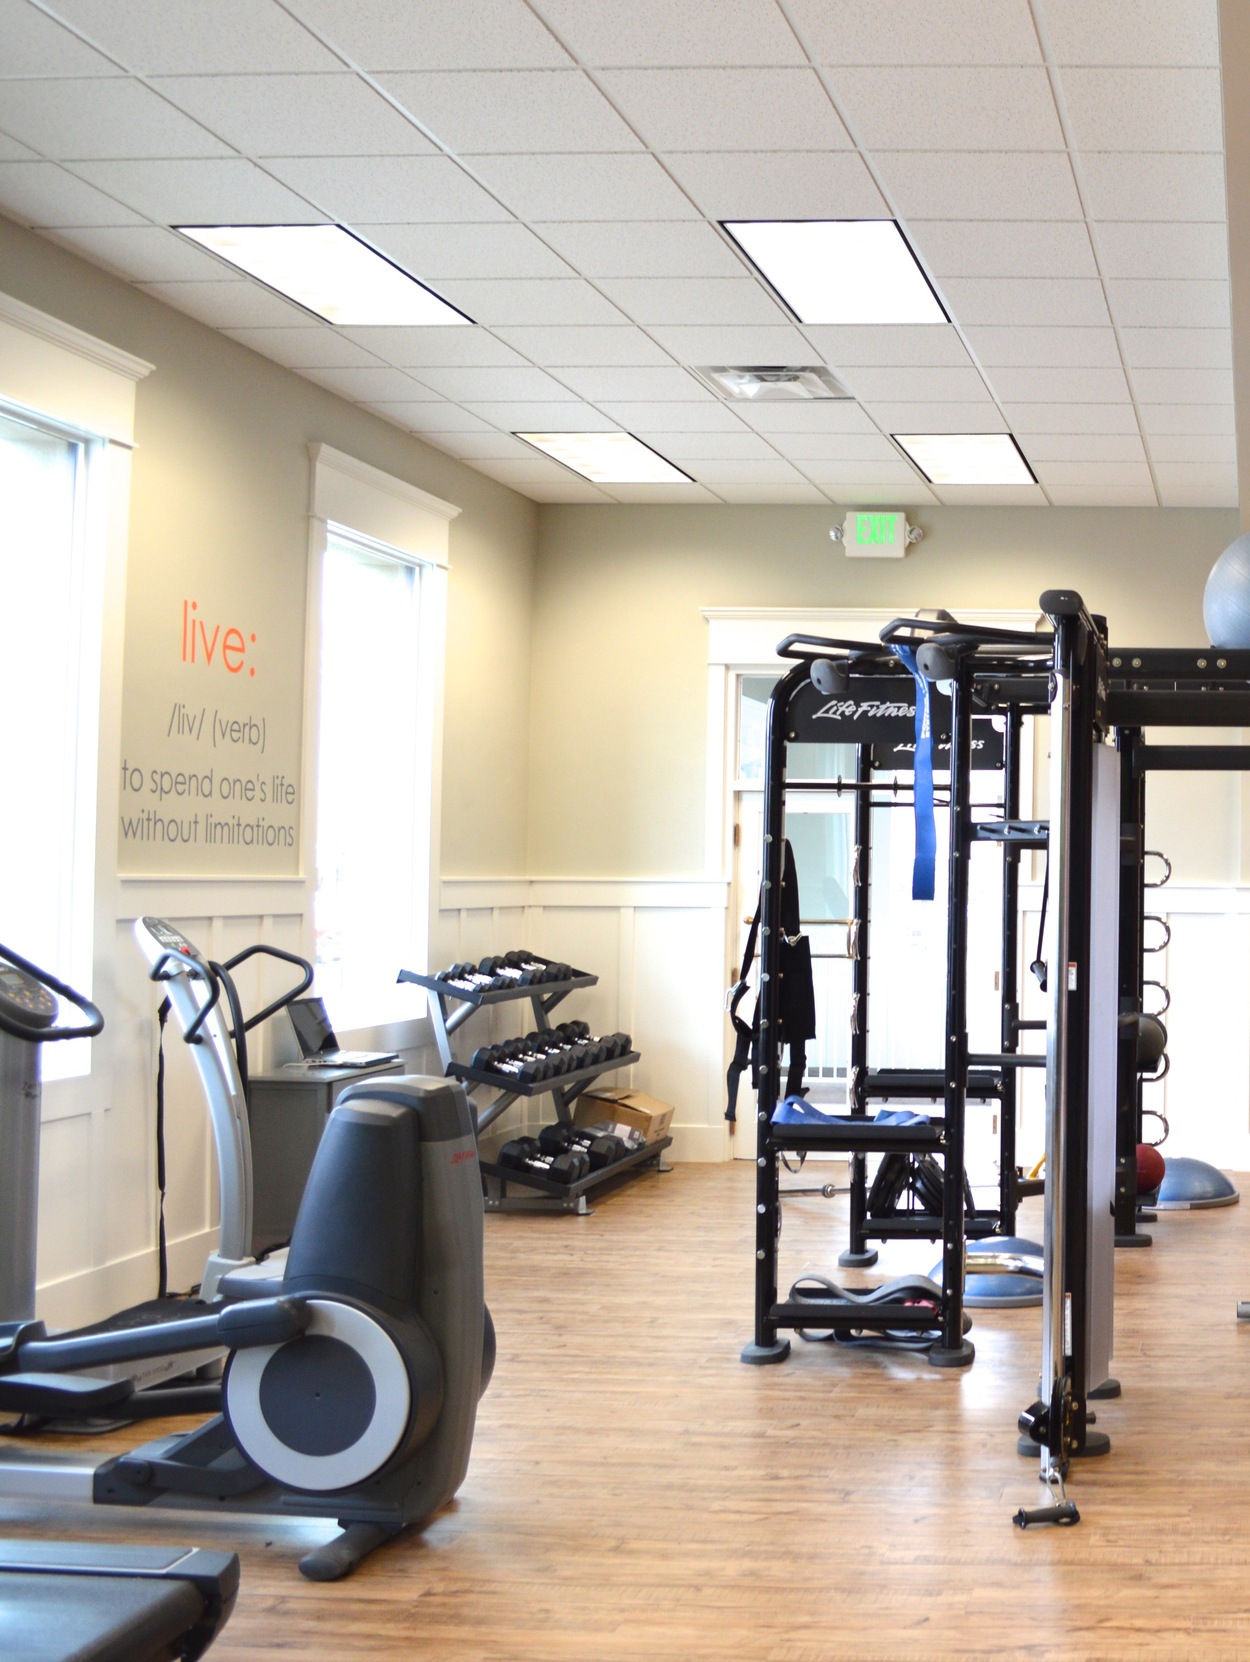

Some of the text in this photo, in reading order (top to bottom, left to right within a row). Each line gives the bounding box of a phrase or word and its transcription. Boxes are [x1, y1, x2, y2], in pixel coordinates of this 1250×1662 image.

[856, 514, 898, 544] EXIT
[181, 599, 257, 678] live:
[167, 702, 266, 755] /liv/ (verb)
[853, 701, 917, 721] Fitnes
[122, 759, 296, 805] to spend one's life
[121, 808, 294, 847] without limitations
